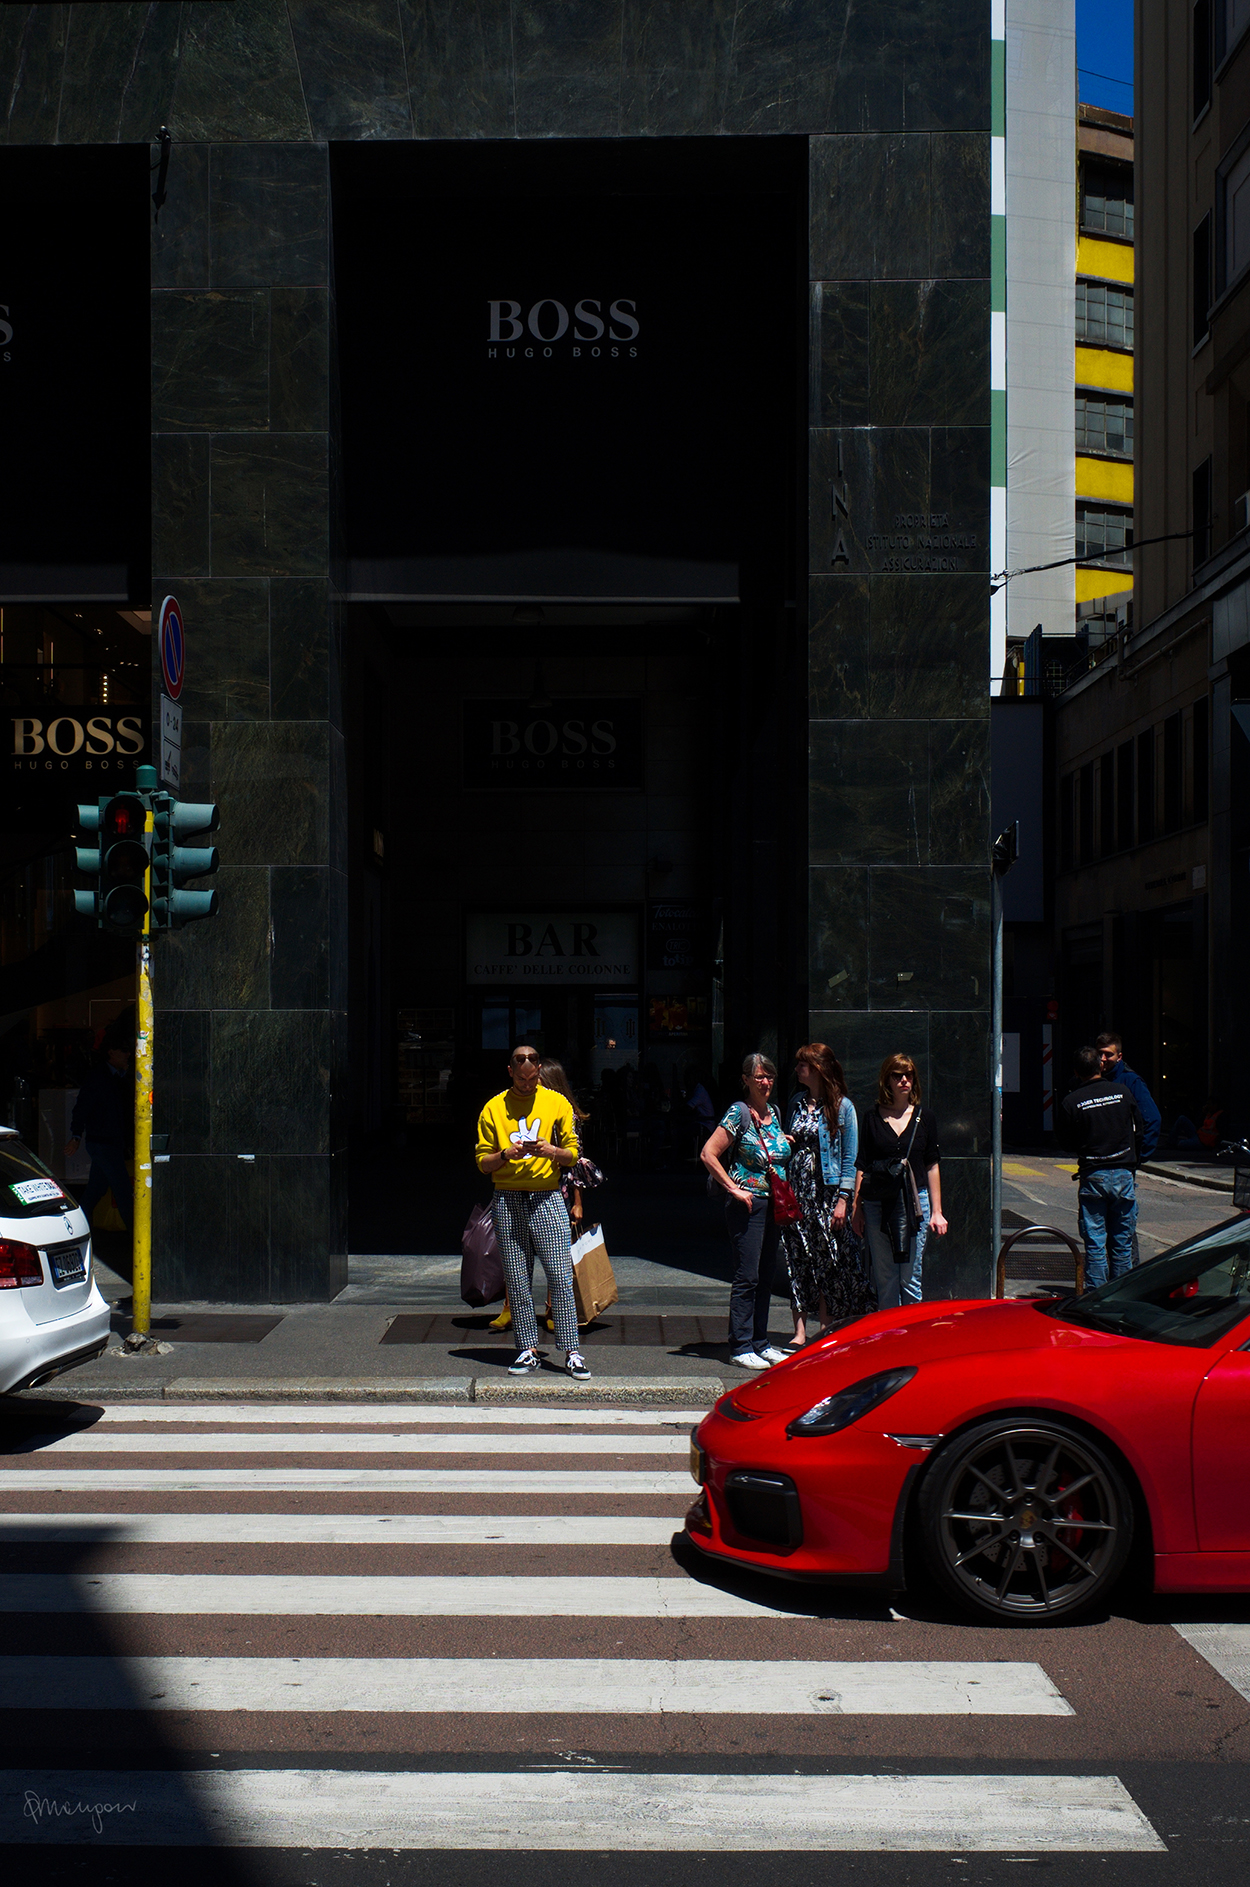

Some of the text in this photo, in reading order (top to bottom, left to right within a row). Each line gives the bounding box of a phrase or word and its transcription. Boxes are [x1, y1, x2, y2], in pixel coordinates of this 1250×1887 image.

[486, 299, 640, 342] BOSS
[488, 347, 638, 358] HUGO BOSS
[865, 536, 977, 550] ISTITUTO NAZIONALE
[882, 557, 959, 571] ASSICURAZIONI
[10, 717, 145, 756] BOSS
[490, 719, 617, 755] BOSS
[14, 760, 140, 770] HUGO BOSS
[491, 760, 616, 769] HUGO BOSS
[504, 922, 601, 957] BAR
[523, 964, 564, 975] DELLE
[568, 964, 631, 975] COLONNE
